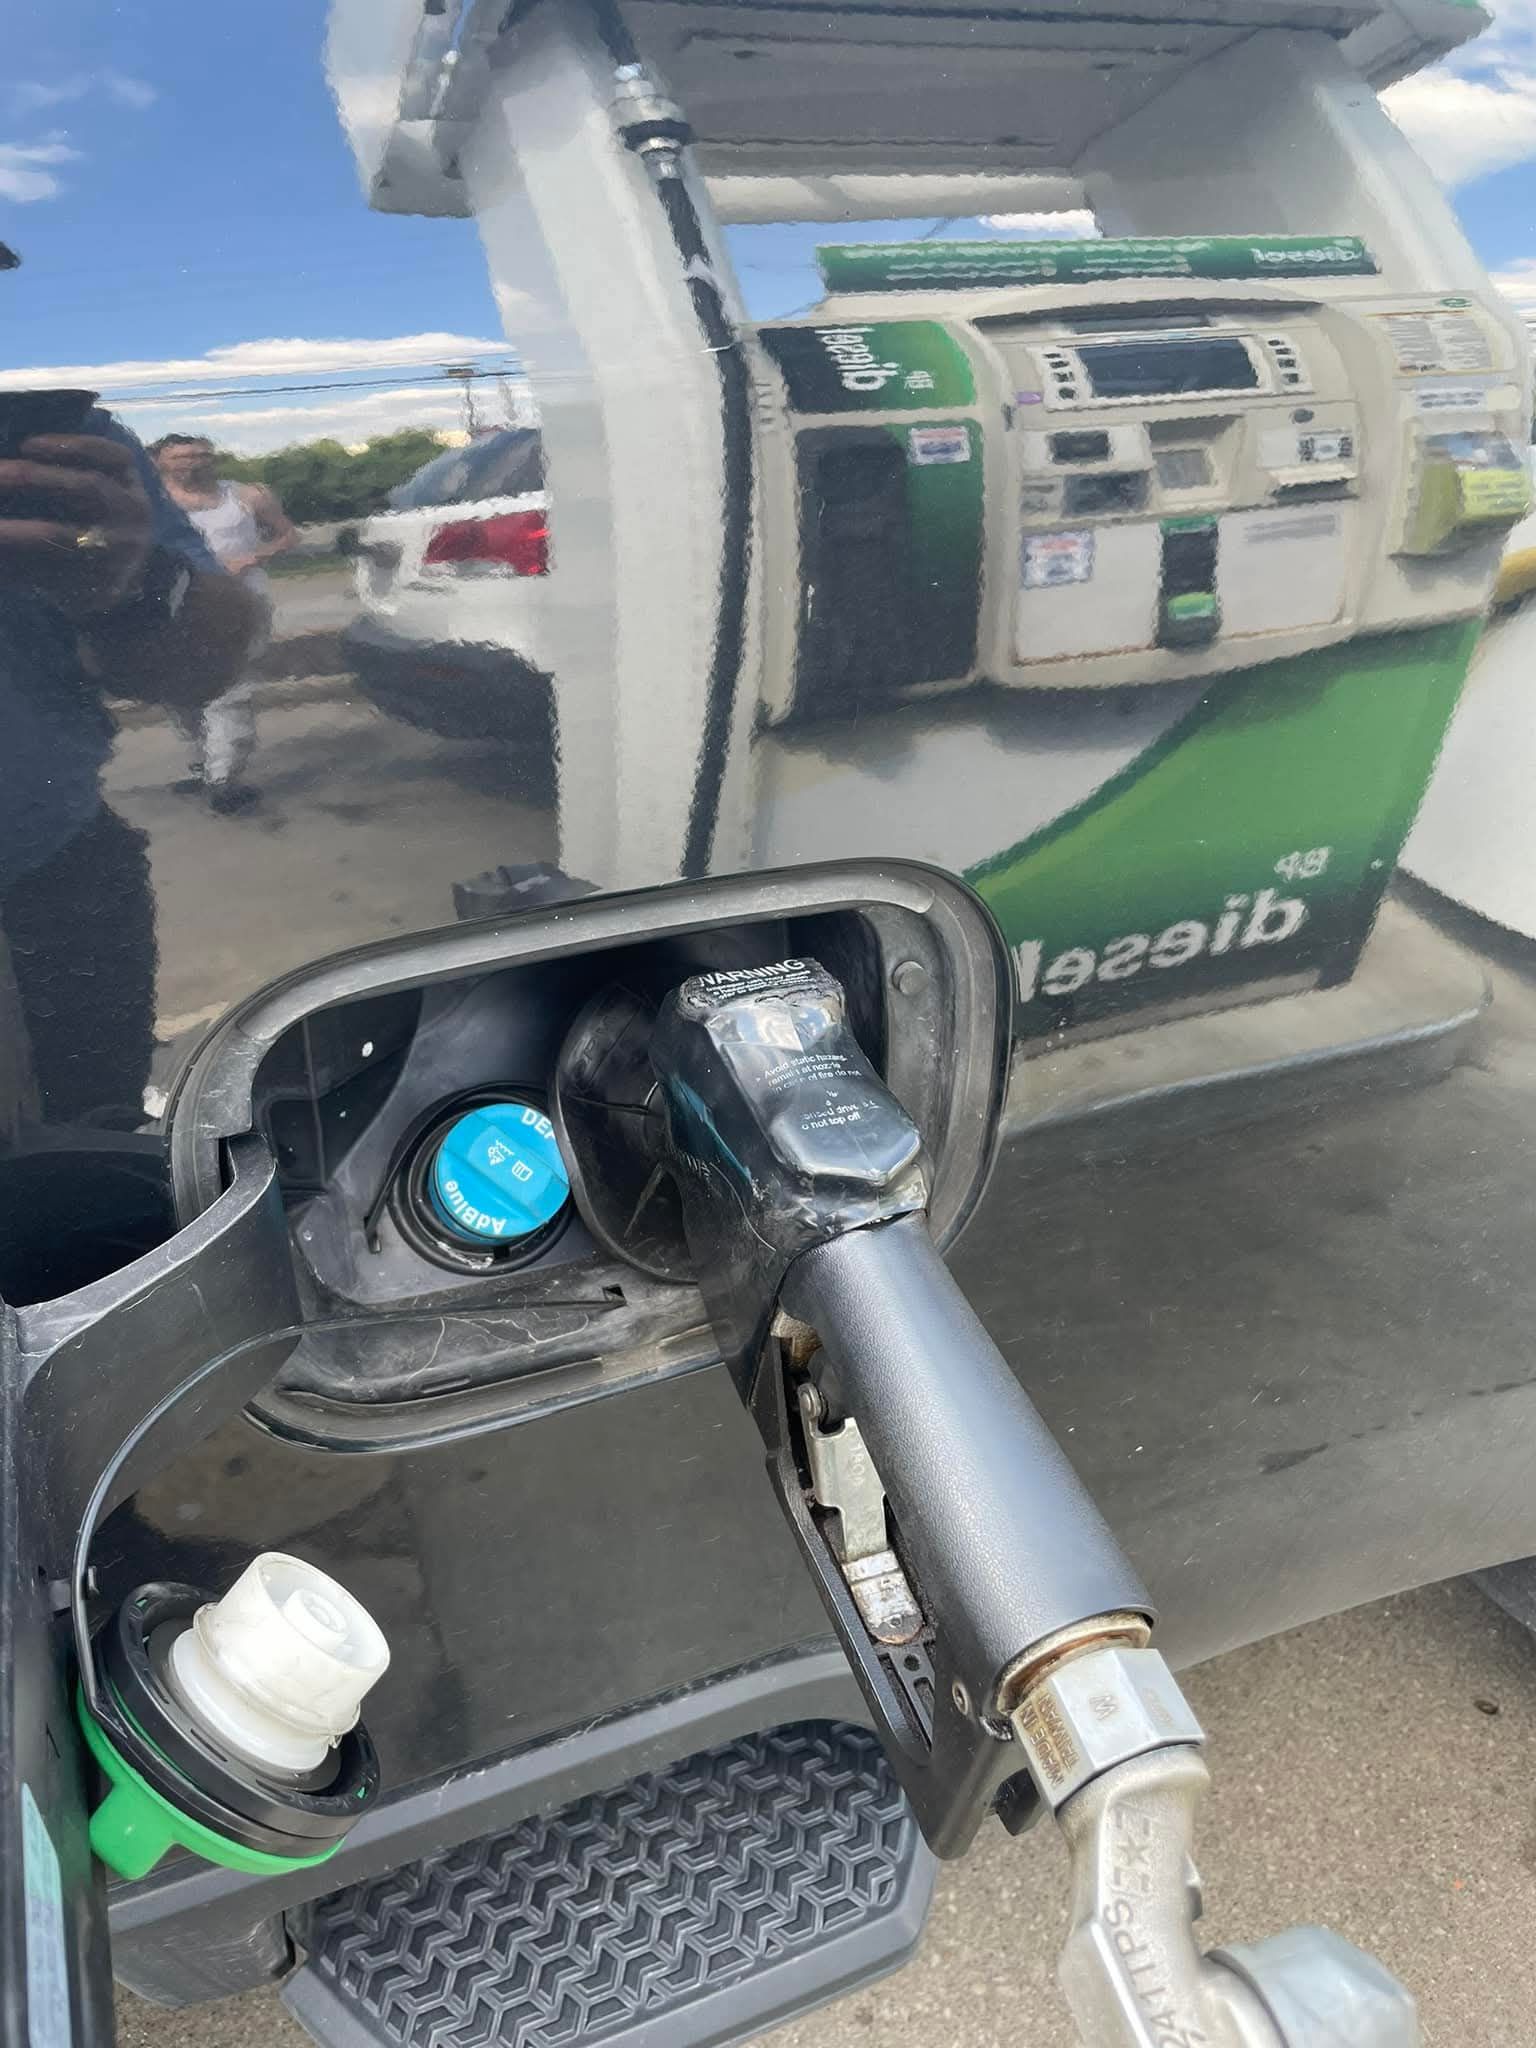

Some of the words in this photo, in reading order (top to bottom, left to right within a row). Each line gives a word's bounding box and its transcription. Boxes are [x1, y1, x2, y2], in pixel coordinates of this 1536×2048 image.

[444, 1179, 508, 1236] AdBlue
[1031, 1732, 1066, 1788] MADE
[1037, 1694, 1080, 1771] TAIWAN
